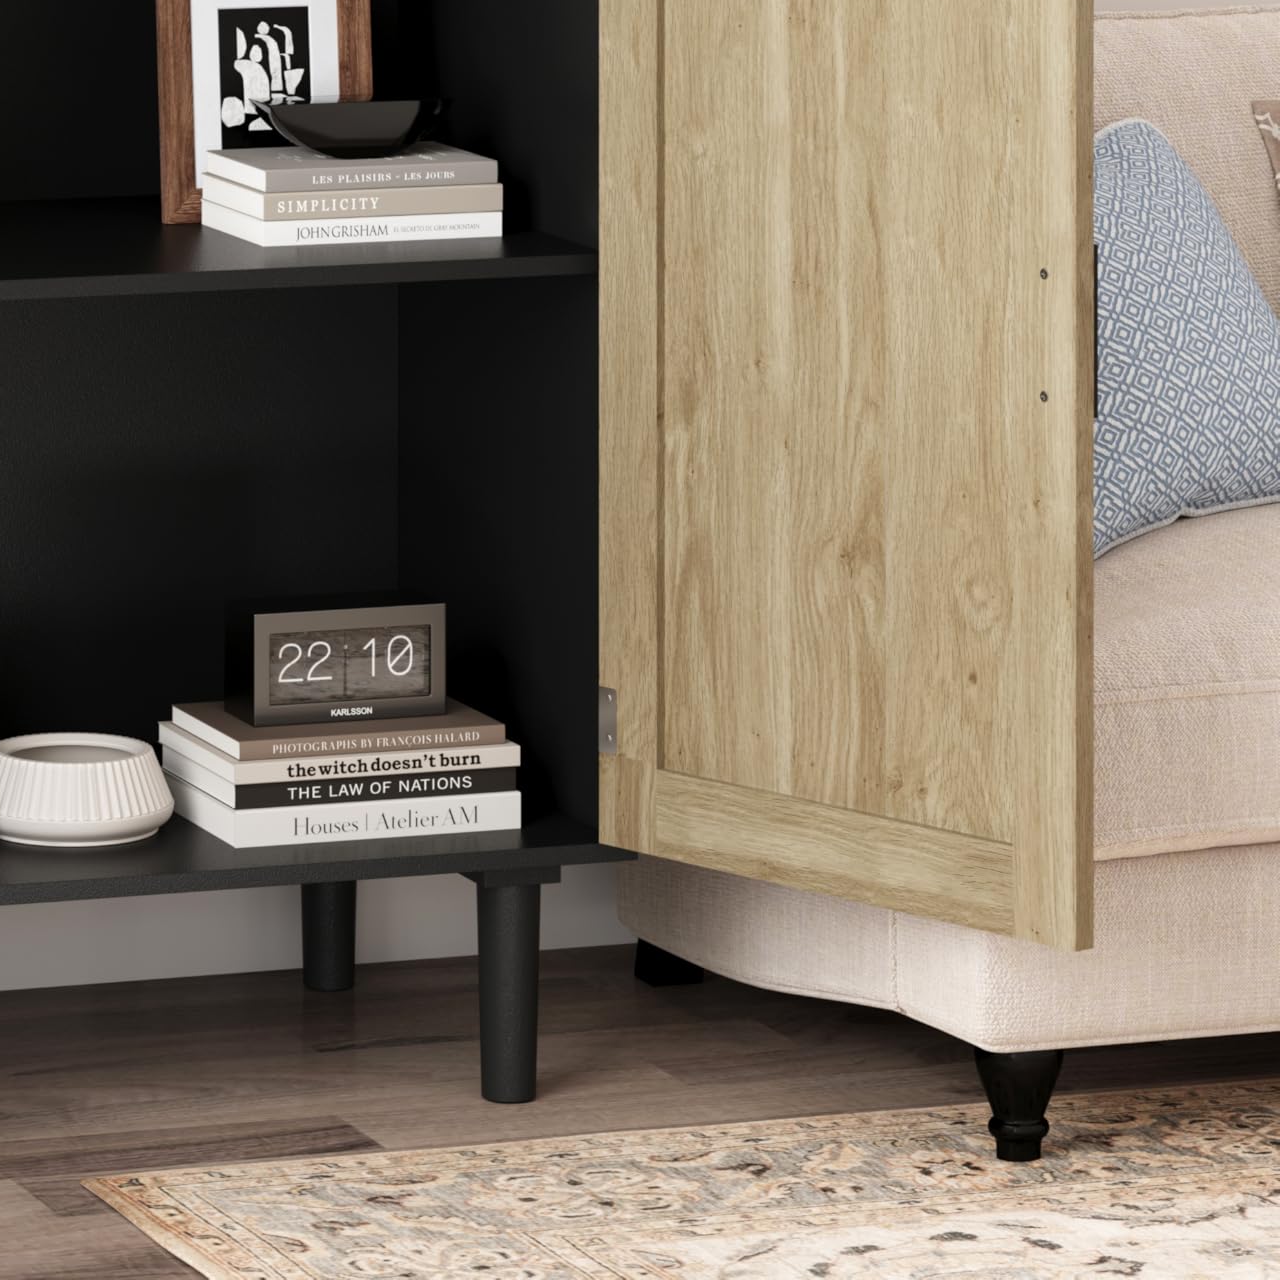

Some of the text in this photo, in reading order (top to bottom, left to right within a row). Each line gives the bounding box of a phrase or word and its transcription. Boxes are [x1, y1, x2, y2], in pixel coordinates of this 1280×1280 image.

[311, 175, 333, 185] LES
[337, 172, 392, 185] PLAISIRS
[403, 171, 422, 181] LES
[425, 170, 456, 181] JOURS
[277, 196, 381, 214] SIMPLICITY
[278, 634, 414, 683] 22 10
[330, 706, 373, 717] KARLSSON
[272, 731, 480, 755] PHOTOGRAPHS BY FRANÇOIS HALARD
[287, 763, 317, 778] the
[317, 760, 369, 776] witch
[439, 752, 481, 768] burn
[287, 775, 473, 801] THE LAW OF NATIONS
[293, 815, 359, 837] Houses
[375, 808, 439, 831] Atelier
[439, 805, 480, 826] AM
